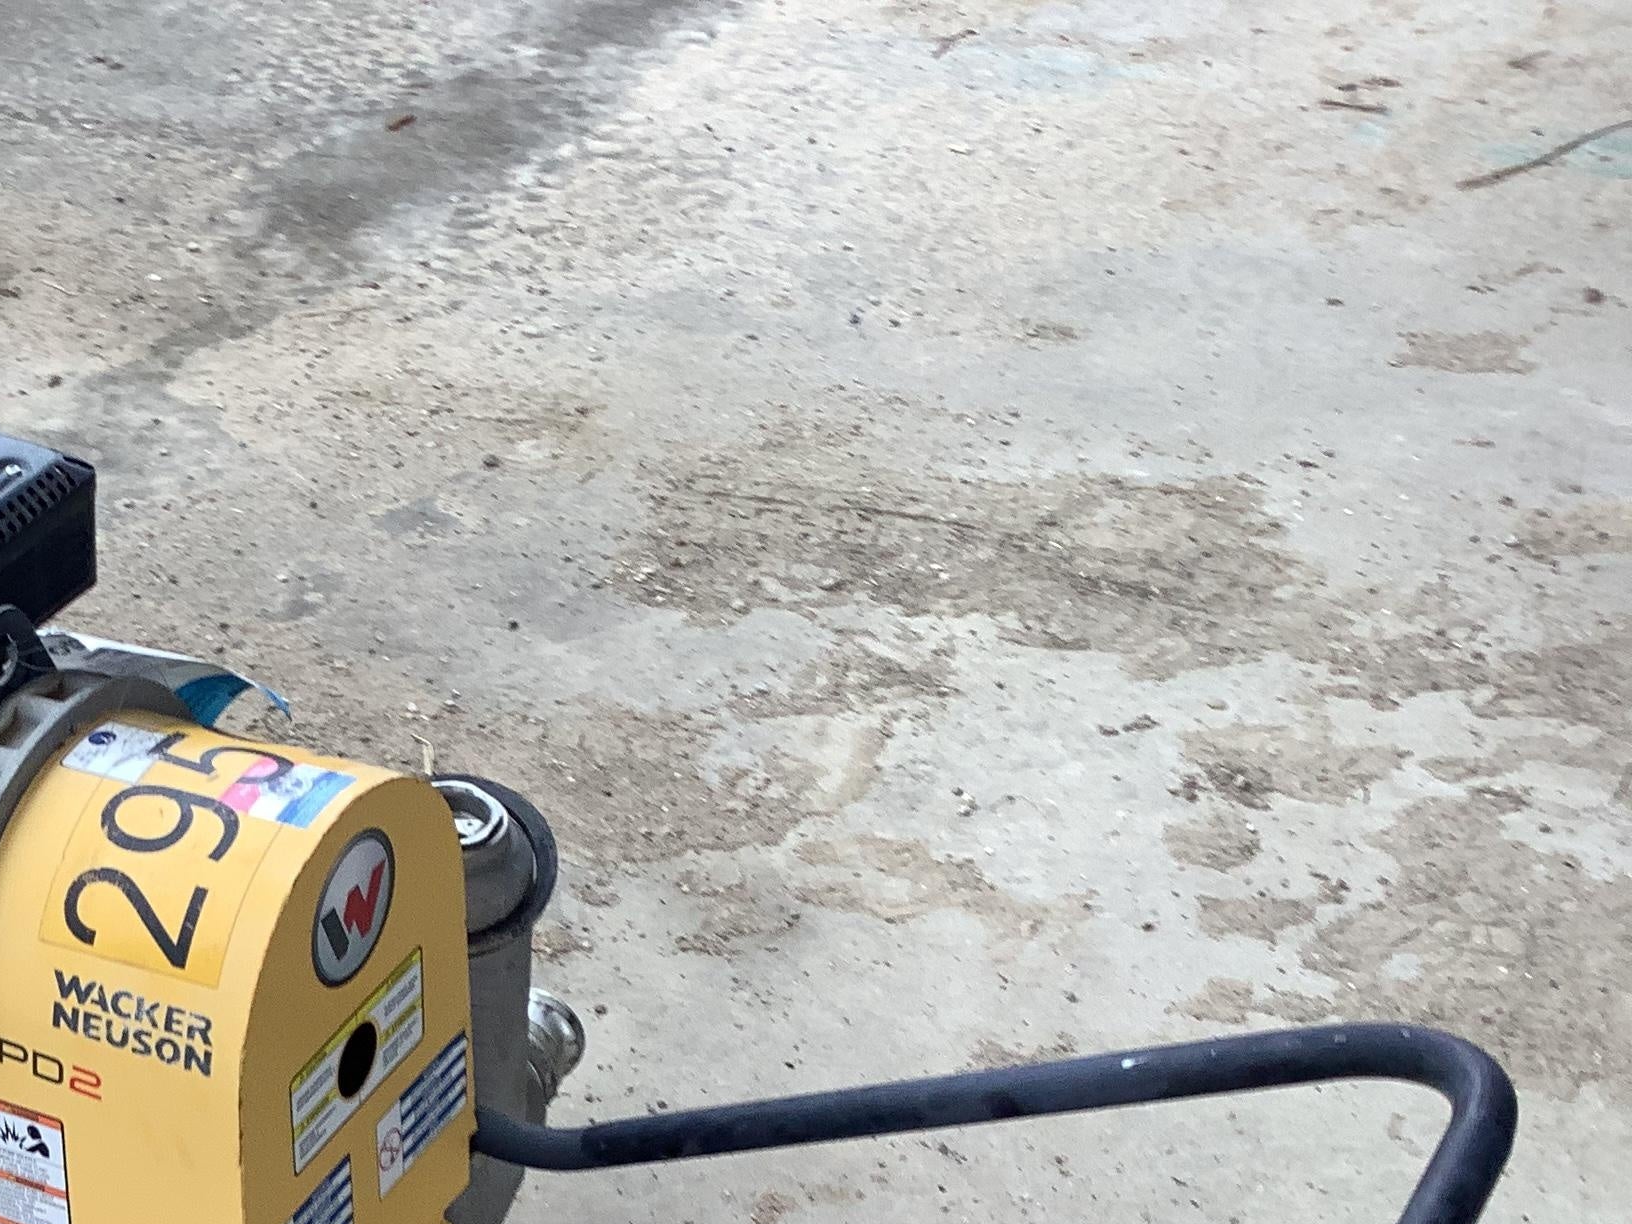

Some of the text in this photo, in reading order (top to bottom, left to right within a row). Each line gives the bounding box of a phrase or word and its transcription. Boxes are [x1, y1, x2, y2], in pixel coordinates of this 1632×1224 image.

[64, 731, 294, 969] 295
[52, 1001, 213, 1077] NEUSON
[54, 968, 213, 1047] WACKER
